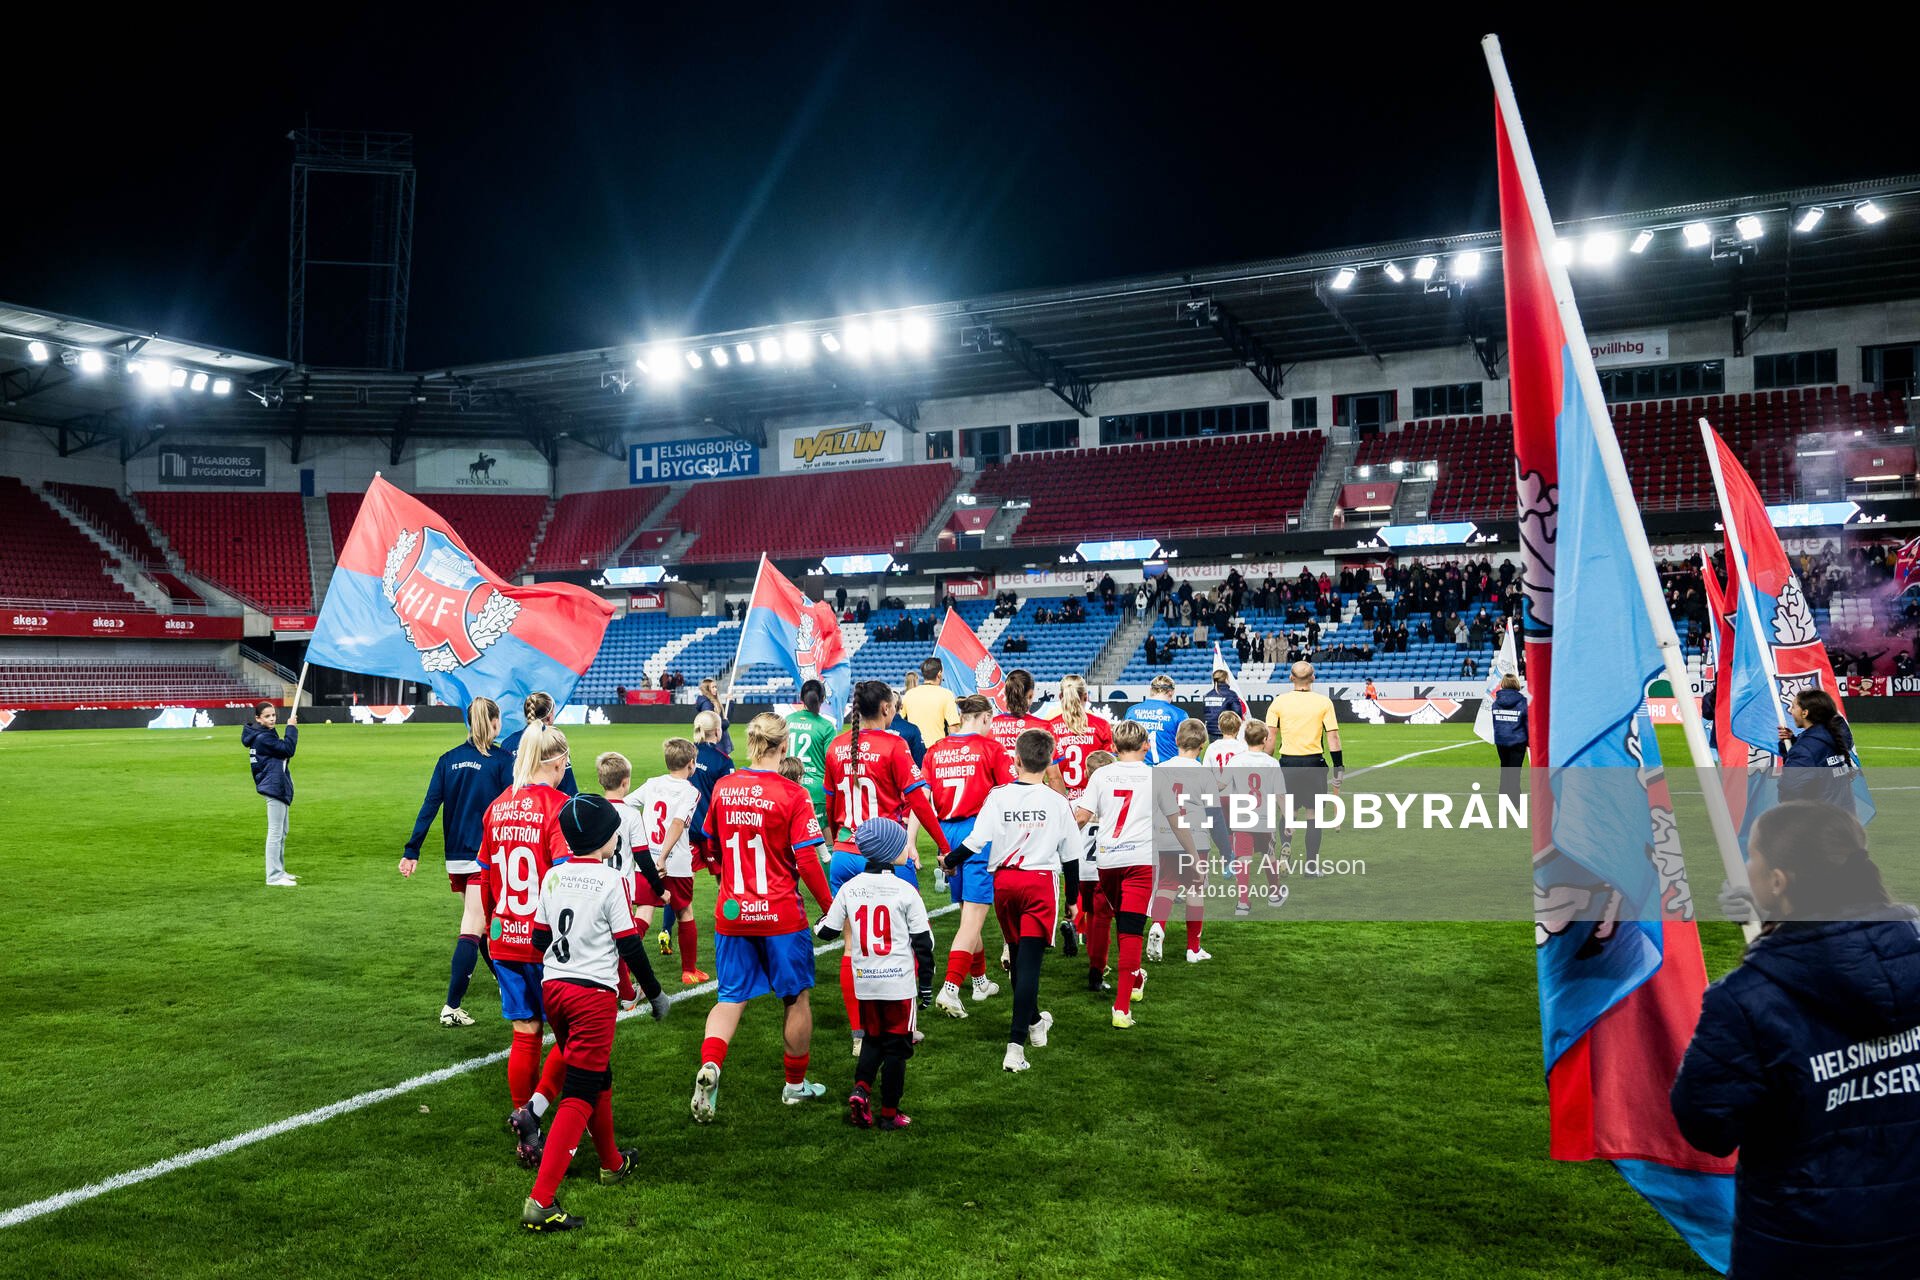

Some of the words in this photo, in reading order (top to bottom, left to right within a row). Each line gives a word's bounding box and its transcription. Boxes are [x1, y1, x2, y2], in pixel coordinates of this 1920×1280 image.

[794, 424, 886, 463] WALLIN
[191, 467, 262, 477] BYGGKONCEPT
[661, 452, 752, 478] BYGGPLÅT
[456, 478, 509, 486] STENBOCKEN
[13, 614, 38, 625] akea
[93, 616, 115, 627] akea
[165, 619, 186, 629] akea
[1136, 714, 1171, 722] TRANSPORT
[992, 727, 1027, 735] TRANSPO
[788, 732, 812, 763] 12
[934, 749, 960, 758] KLIMAT
[934, 753, 981, 765] TRANSPORT
[1063, 745, 1082, 786] 3
[935, 765, 975, 779] RAHMBERG
[720, 787, 749, 797] KLIMAT
[943, 778, 967, 820] 7
[492, 800, 520, 812] KLIMAT
[721, 797, 775, 811] TRANSPORT
[837, 776, 879, 828] 10
[492, 810, 544, 824] TRANSPORT
[726, 811, 763, 827] LARSSON
[1004, 810, 1047, 822] EKETS
[1113, 789, 1134, 839] 7
[651, 800, 668, 845] 3
[726, 832, 768, 895] 11
[491, 845, 539, 916] 19
[559, 882, 602, 893] NORDIC
[561, 875, 604, 887] PARAGON
[741, 900, 769, 913] Solid
[741, 913, 778, 922] Försäkring
[502, 919, 529, 934] Solid
[855, 904, 892, 957] 19
[552, 908, 574, 964] 8
